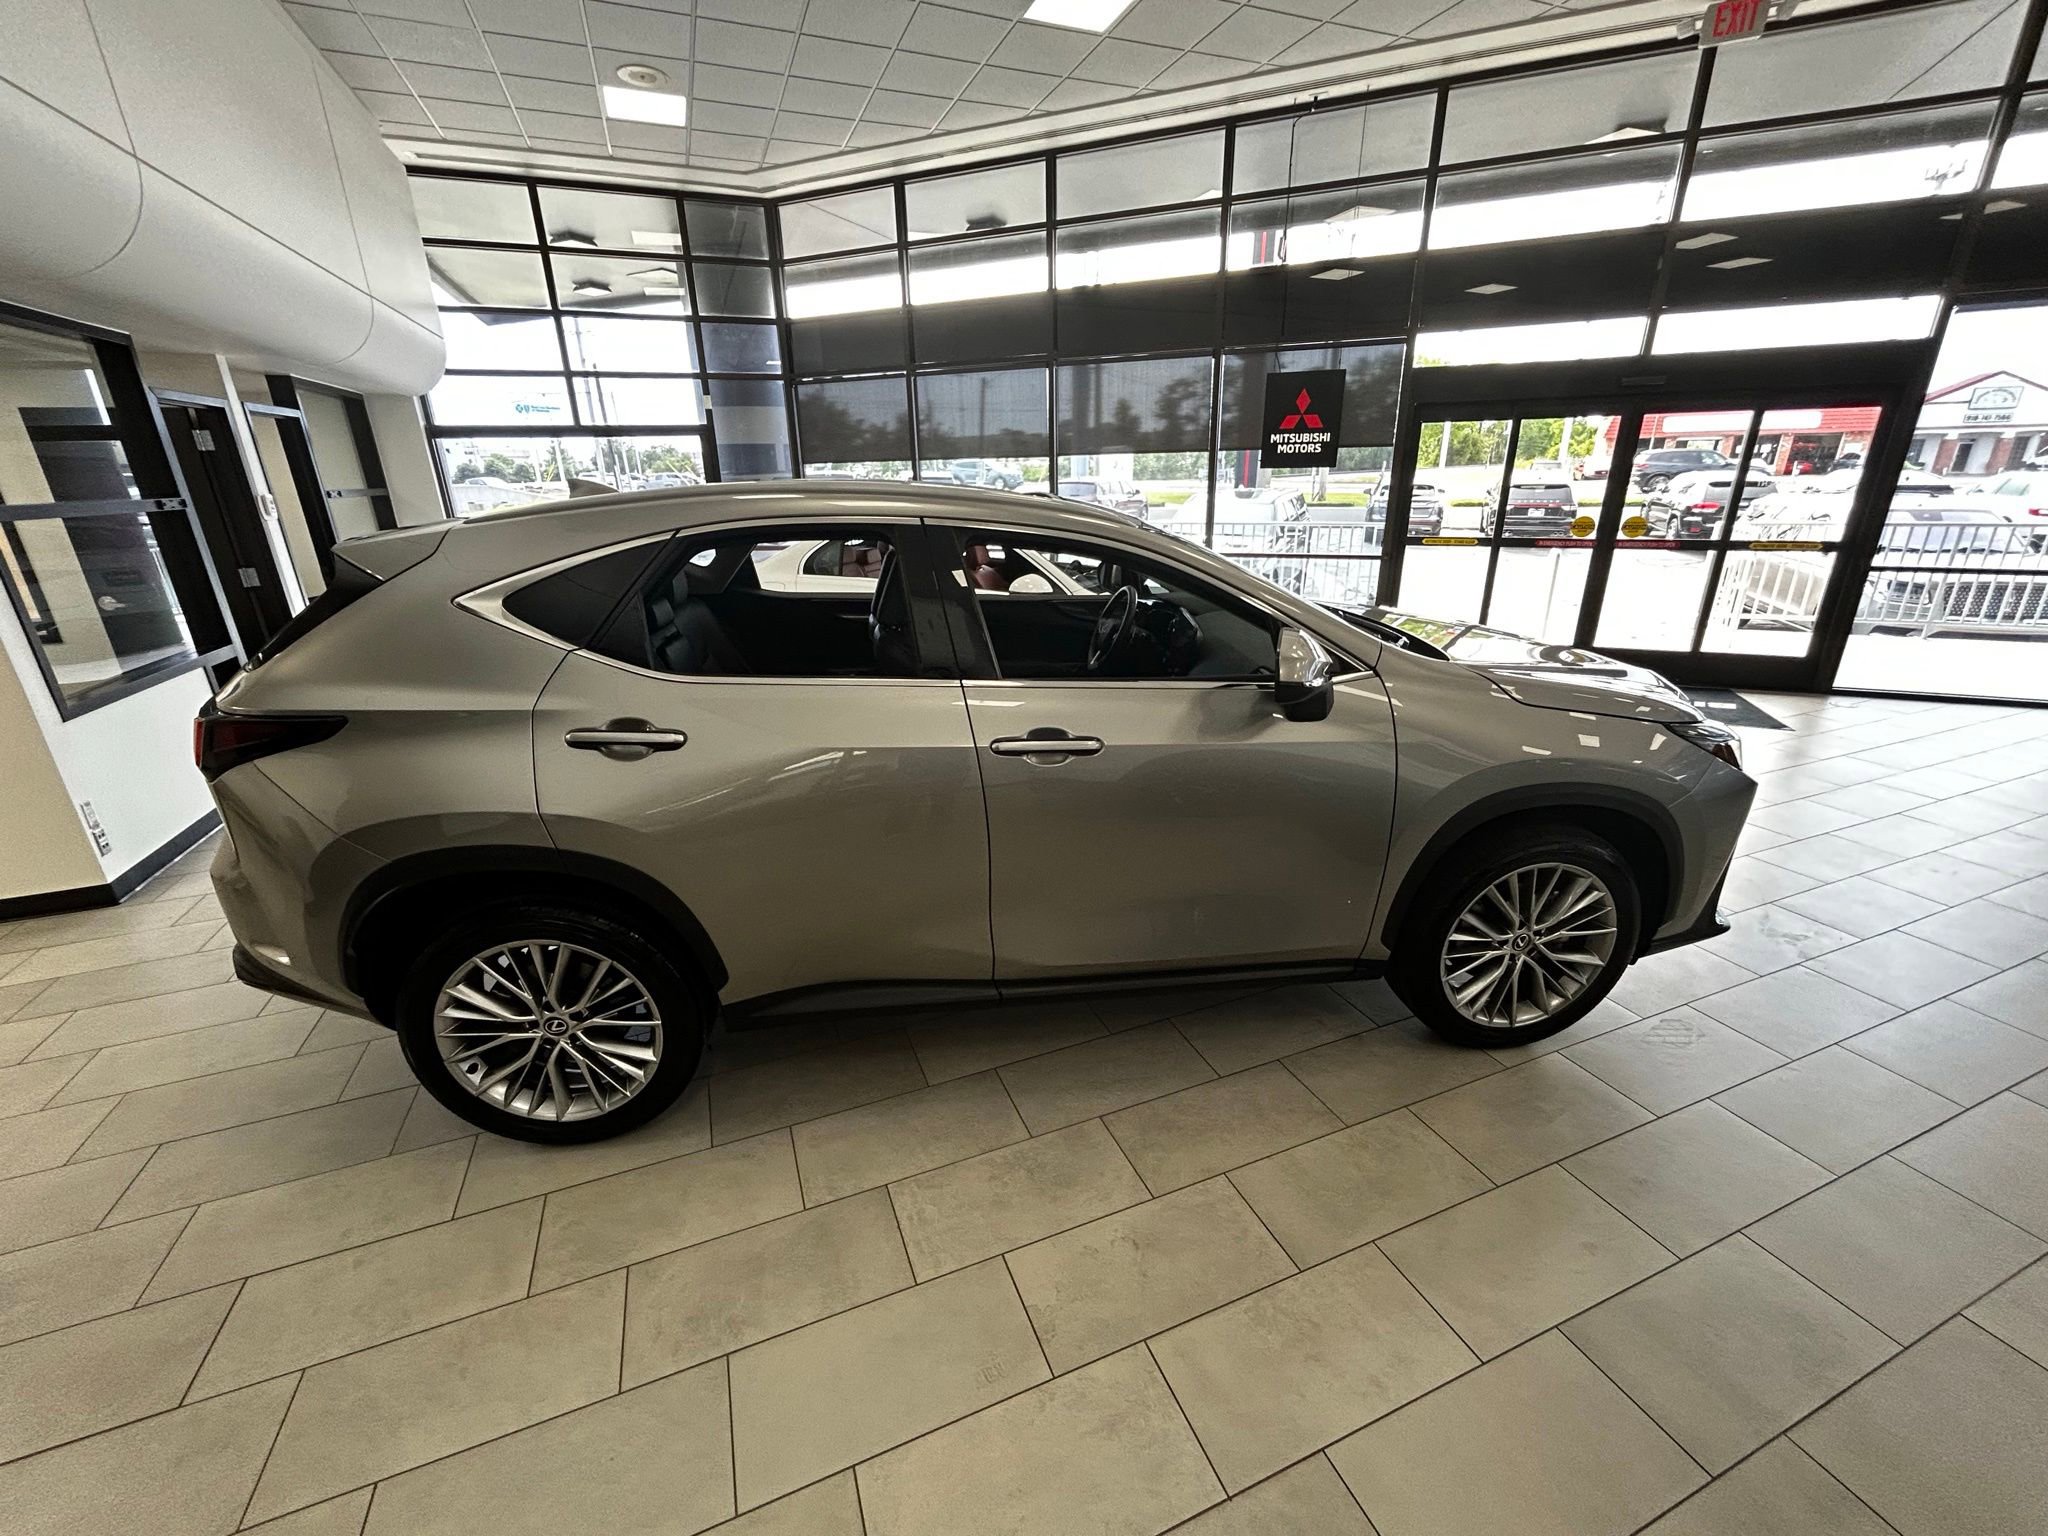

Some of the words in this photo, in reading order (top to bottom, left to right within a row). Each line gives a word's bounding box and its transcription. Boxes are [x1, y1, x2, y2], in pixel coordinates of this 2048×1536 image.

[1712, 0, 1760, 37] EXIT
[1270, 432, 1331, 443] MITSUBISHI
[1277, 443, 1322, 454] MOTORS
